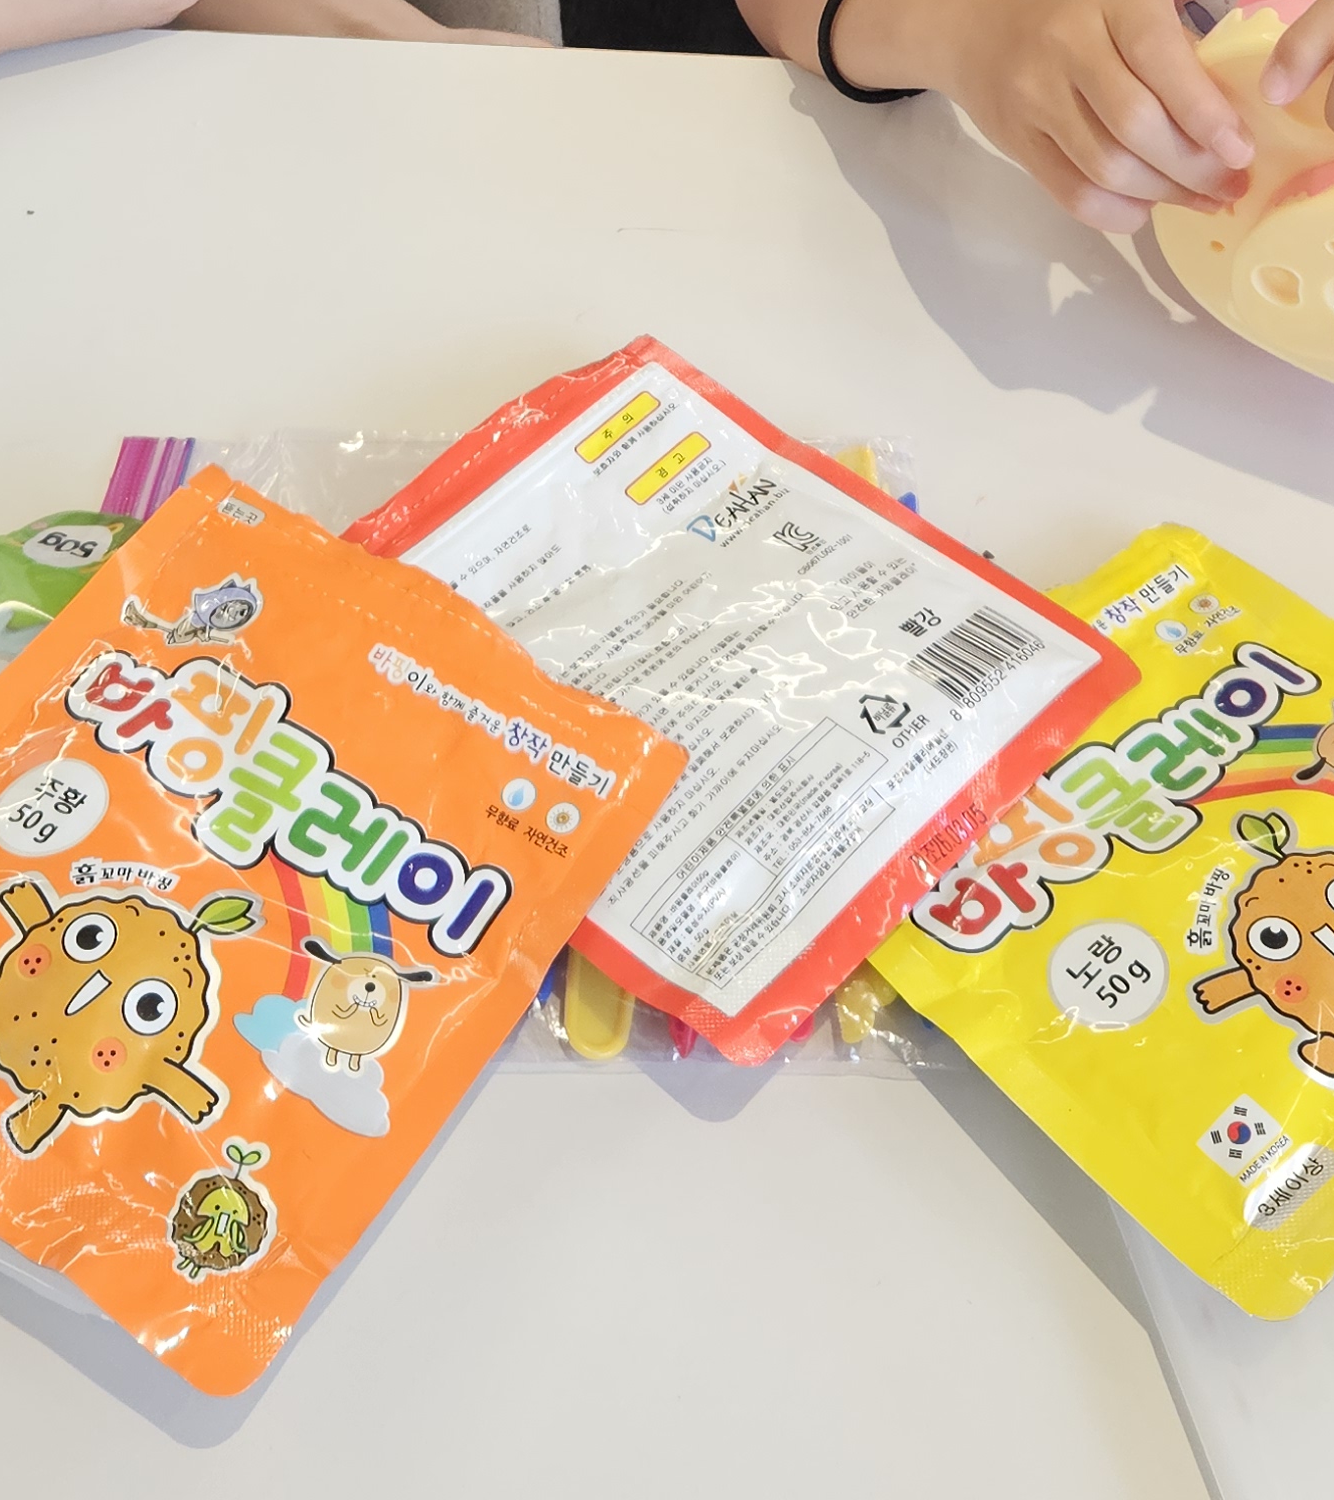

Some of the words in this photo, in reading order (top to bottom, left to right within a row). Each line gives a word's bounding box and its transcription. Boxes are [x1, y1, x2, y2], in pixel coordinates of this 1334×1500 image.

[656, 491, 670, 505] 3세
[668, 479, 684, 494] 미만
[683, 455, 712, 481] 사용금지
[37, 532, 97, 557] 50g
[718, 485, 790, 549] www.eahan.biz
[897, 602, 943, 643] 빨강
[1102, 591, 1143, 628] 창작
[1137, 561, 1190, 606] 만들기
[948, 706, 964, 722] 8
[961, 667, 1007, 709] 809552
[1004, 637, 1046, 672] 416046
[368, 645, 442, 700] 바핑이와
[438, 689, 467, 713] 함께
[464, 703, 503, 735] 즐거운
[499, 717, 552, 767] 창작
[543, 743, 615, 801] 만들기
[871, 701, 897, 725] 비닐류
[890, 712, 931, 750] OTHER
[30, 770, 89, 822] 주황
[83, 660, 497, 943] 바핑클레이
[651, 796, 686, 833] 사용하지
[674, 836, 719, 881] 어린이제품
[760, 770, 781, 791] 의한
[777, 753, 797, 773] 표시
[927, 649, 1307, 937] 바핑클레이
[482, 802, 521, 835] 무향료
[520, 823, 571, 862] 자연건조
[646, 816, 691, 860] 피해주시고
[687, 799, 708, 820] 화기
[770, 853, 787, 870] TEL
[1063, 930, 1126, 990] 노랑
[1238, 1159, 1262, 1183] MADE
[1258, 1152, 1269, 1163] IN
[1265, 1134, 1290, 1158] KOREA
